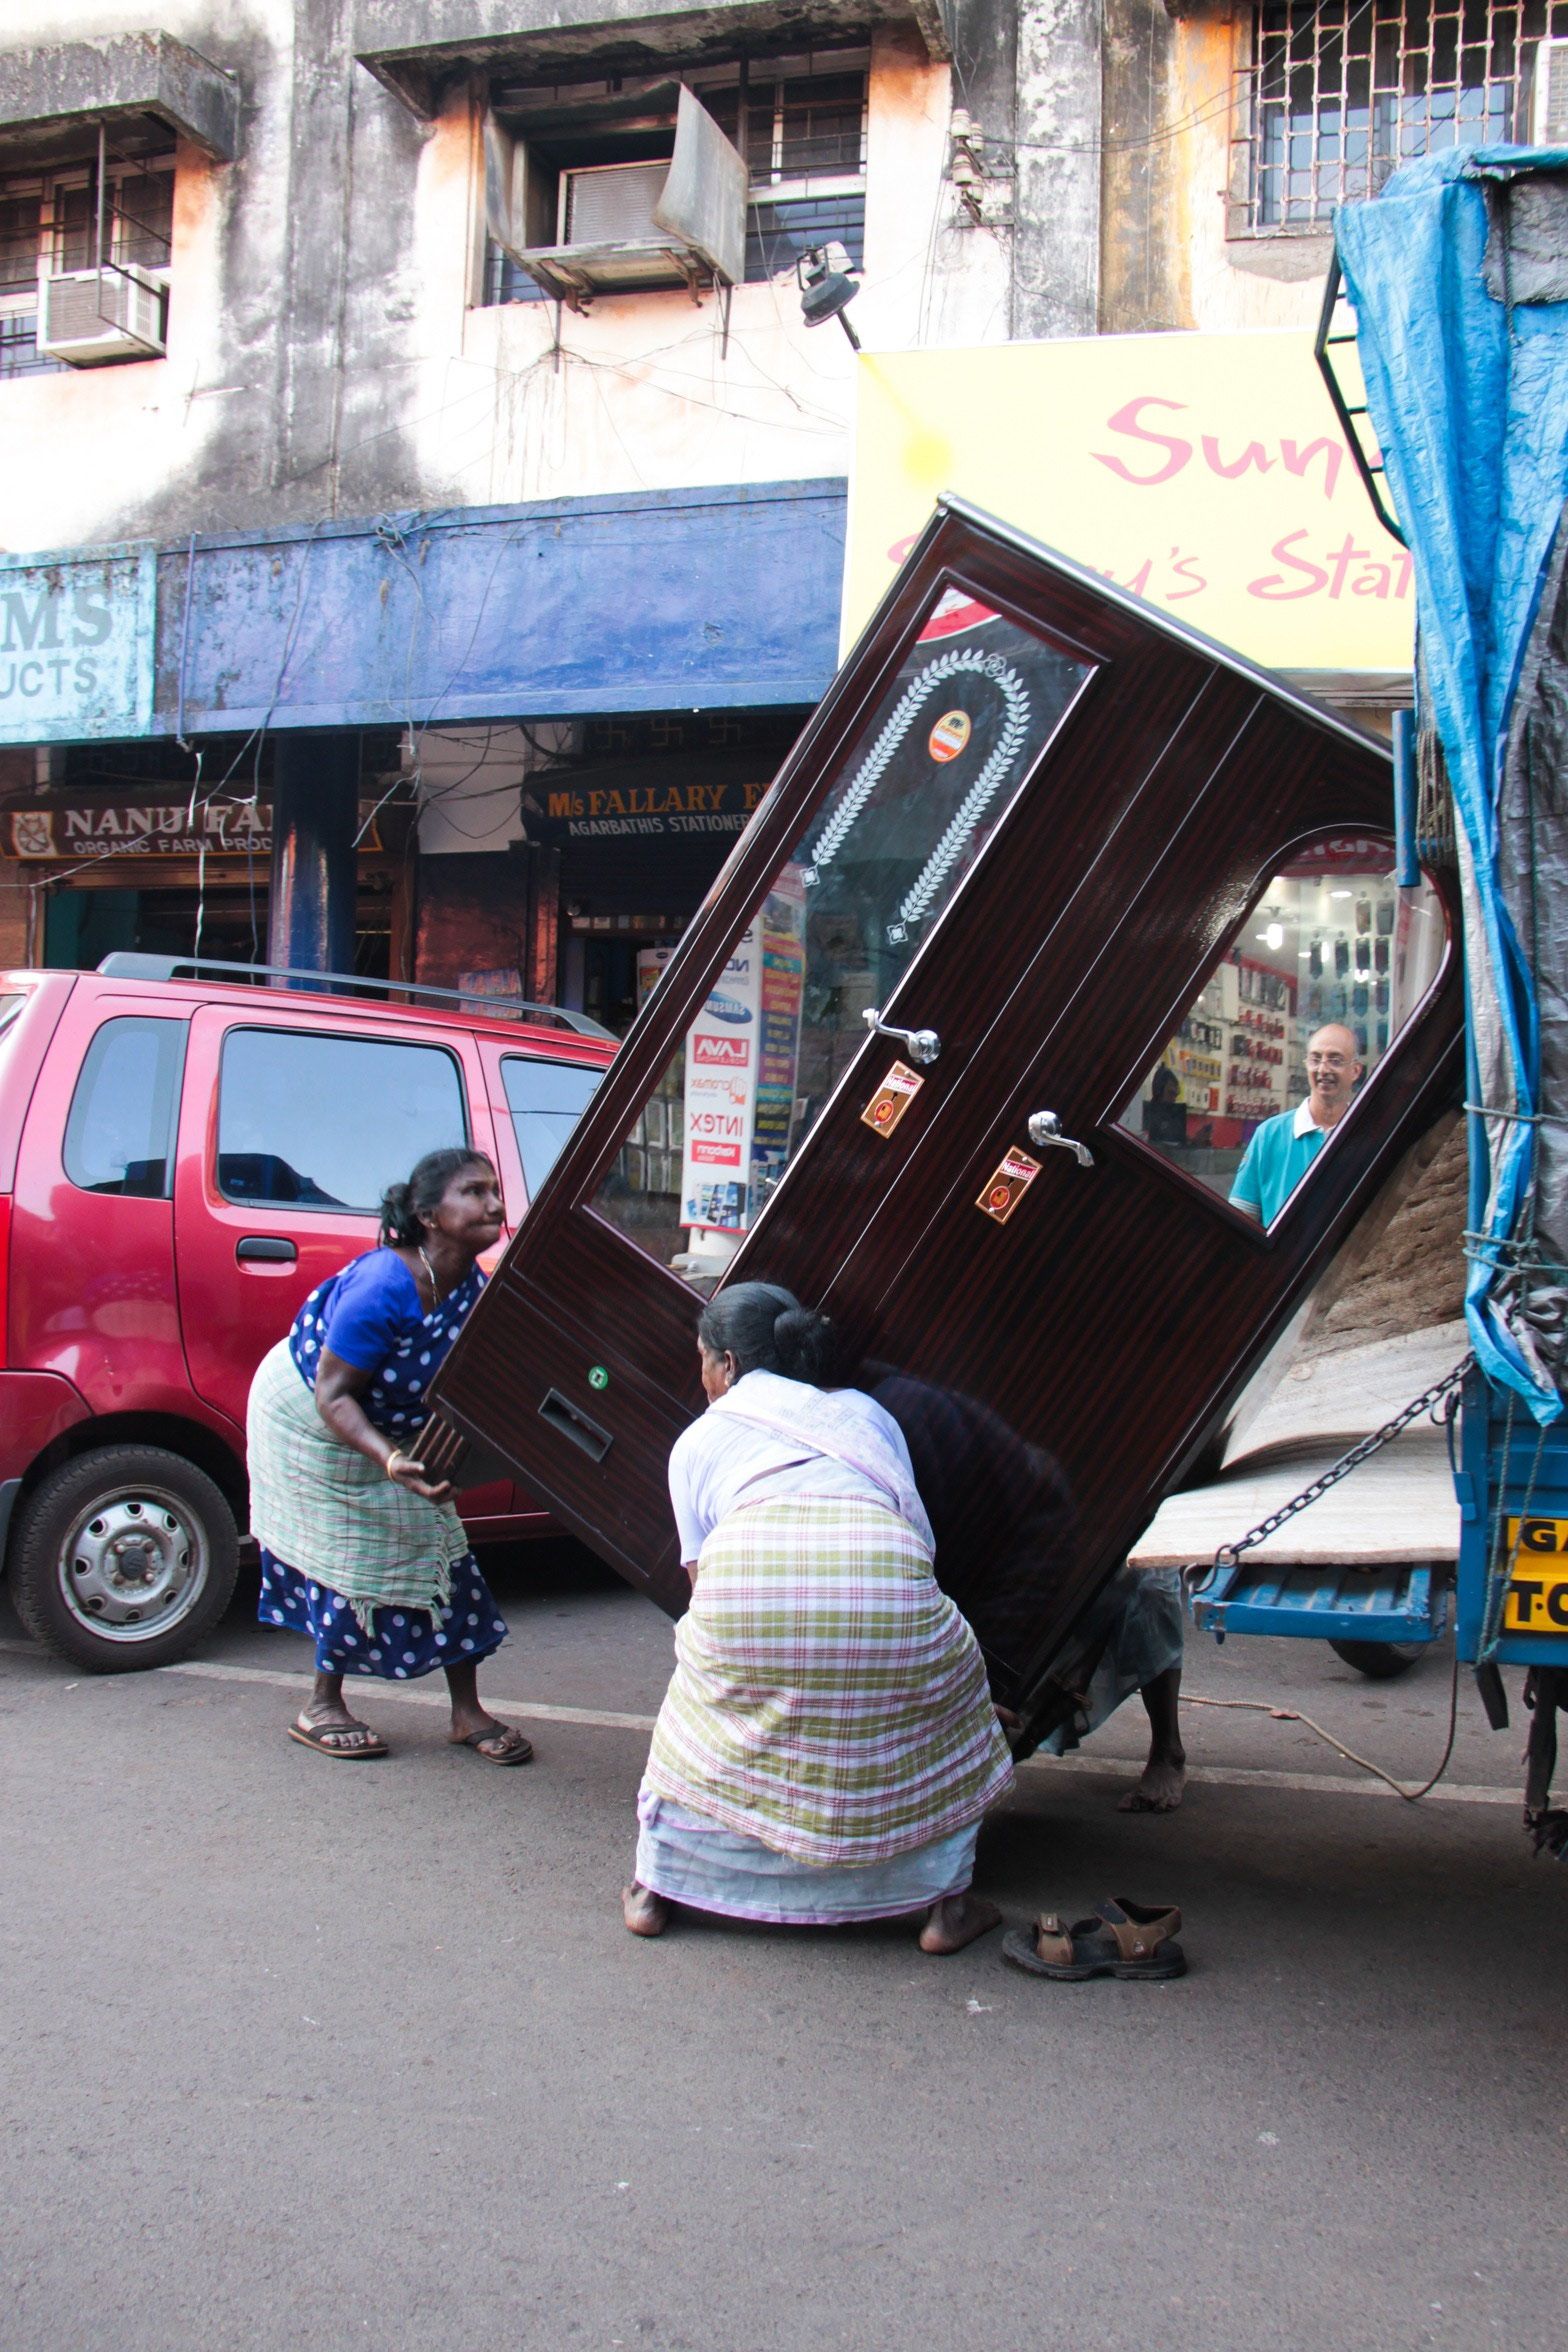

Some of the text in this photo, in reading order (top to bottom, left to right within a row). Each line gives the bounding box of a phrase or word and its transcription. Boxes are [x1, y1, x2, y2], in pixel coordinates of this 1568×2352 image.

[588, 784, 728, 817] FALLARY
[205, 803, 273, 834] FA
[568, 816, 664, 837] AGARBATHIS
[73, 839, 151, 855] ORGANIC
[157, 837, 214, 853] FARM
[1002, 1161, 1036, 1179] National
